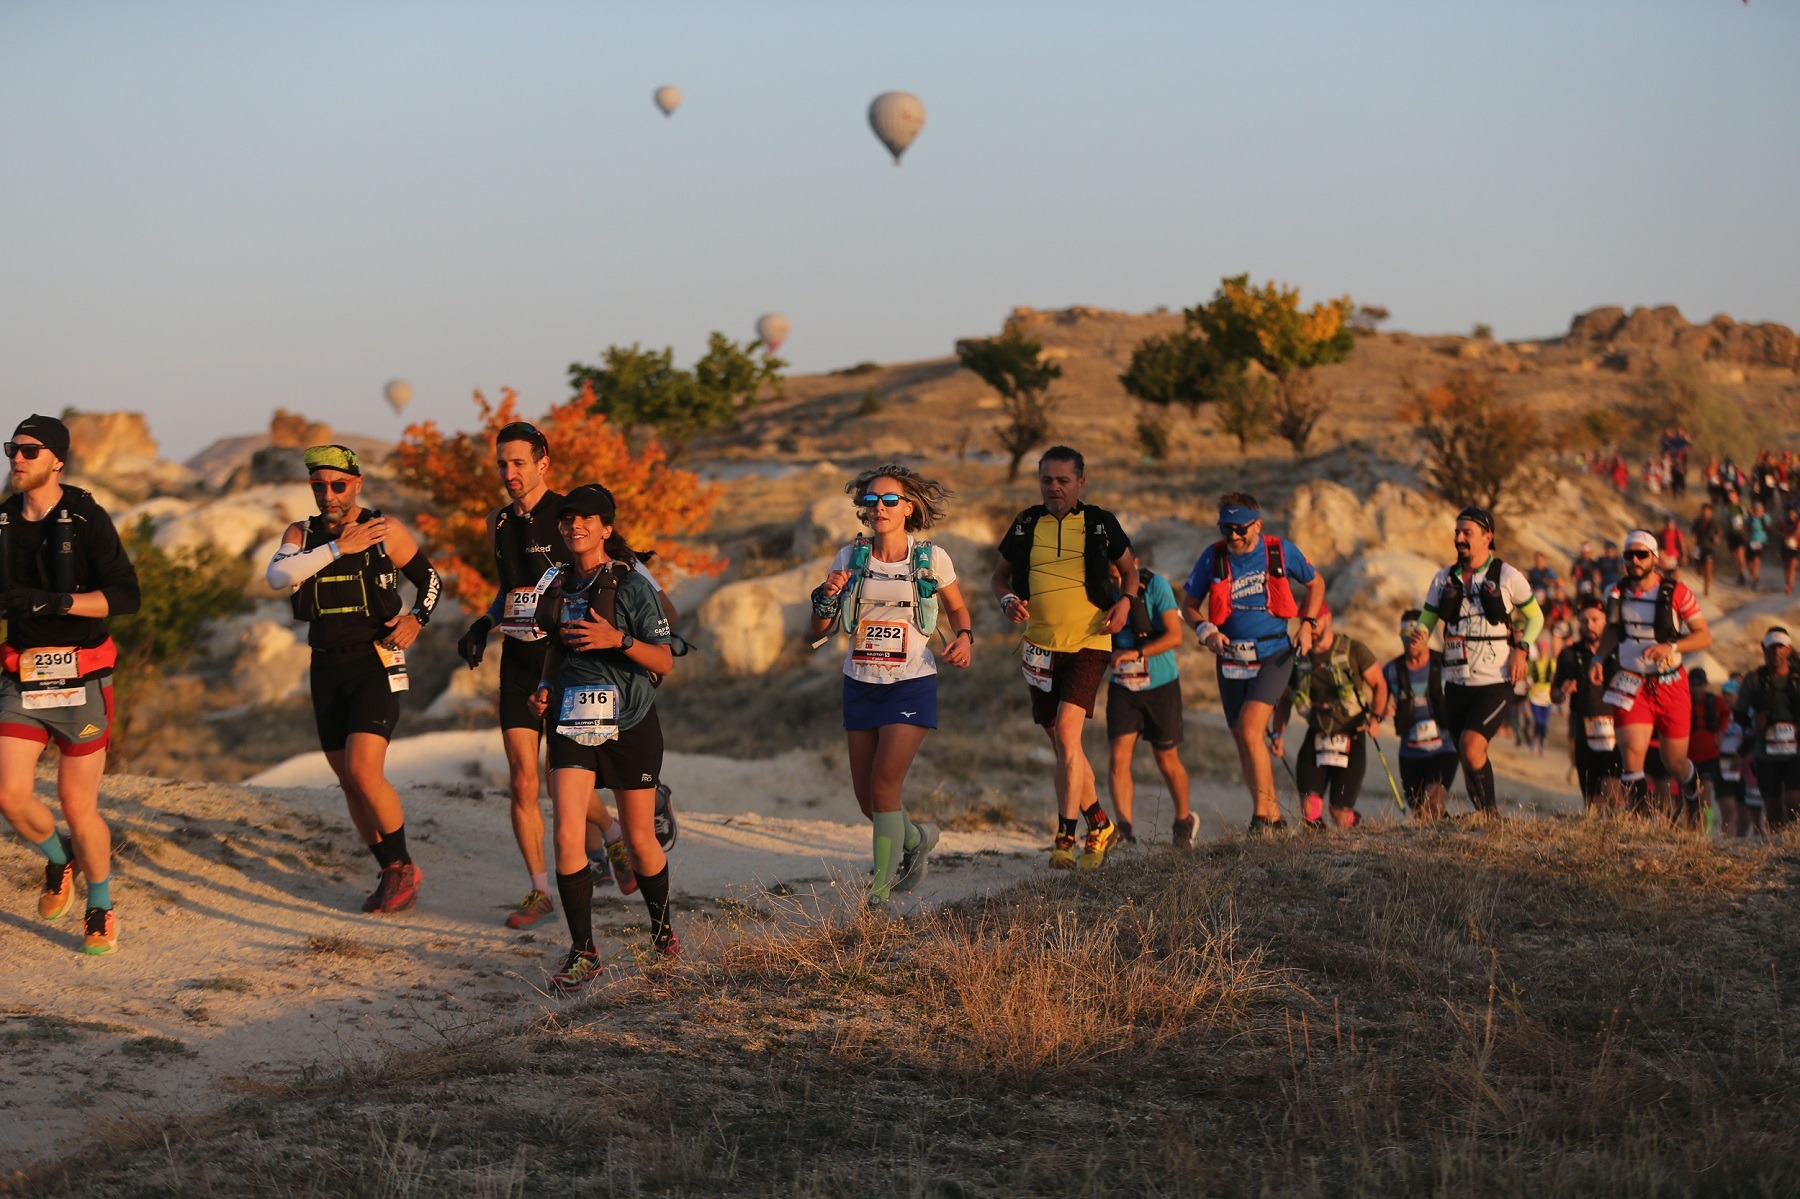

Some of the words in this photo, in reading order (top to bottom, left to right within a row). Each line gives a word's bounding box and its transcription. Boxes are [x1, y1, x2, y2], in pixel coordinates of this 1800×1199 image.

[525, 544, 551, 553] naked
[866, 626, 901, 639] 2252
[34, 653, 72, 666] 2390
[579, 692, 607, 705] 316
